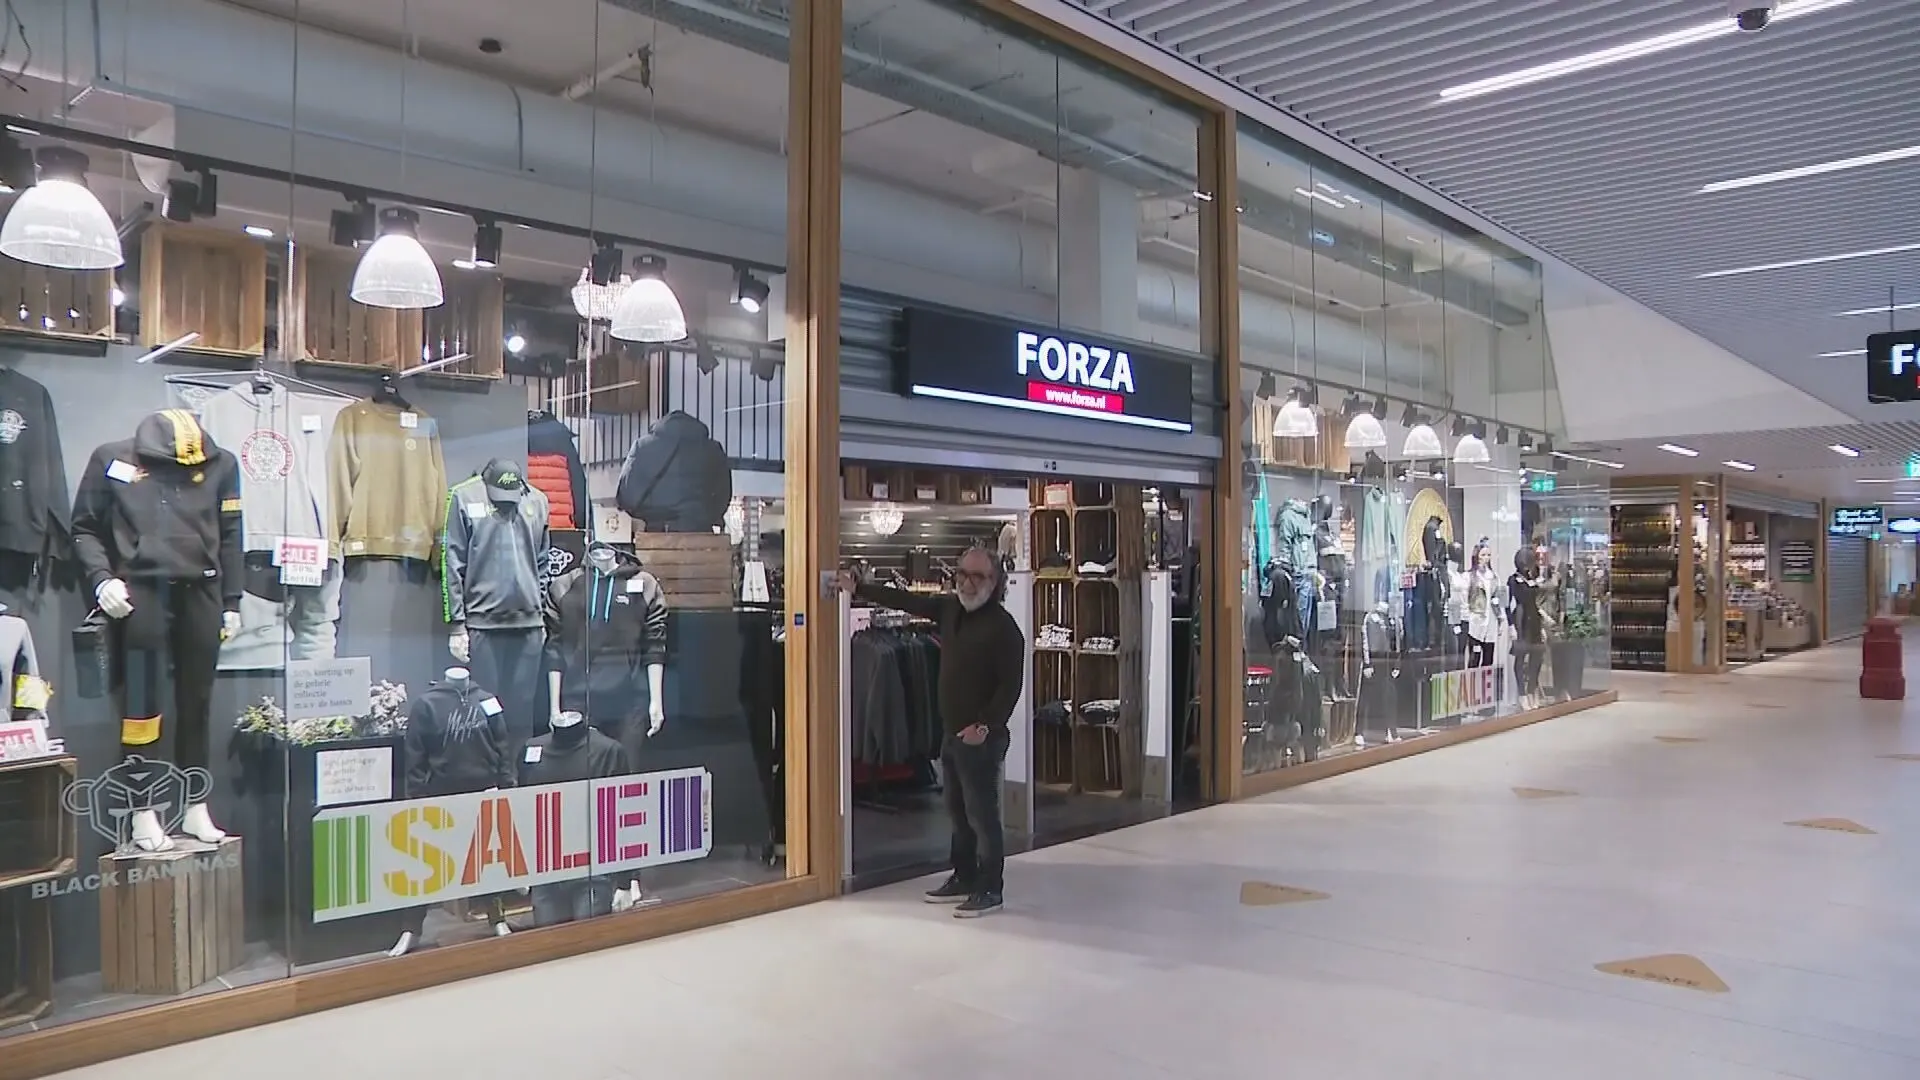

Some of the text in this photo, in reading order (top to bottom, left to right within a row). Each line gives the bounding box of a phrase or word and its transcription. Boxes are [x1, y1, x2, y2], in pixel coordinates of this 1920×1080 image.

[1018, 332, 1135, 393] FORZA
[1891, 344, 1920, 374] F
[1046, 390, 1105, 409] www.forza.nl
[281, 547, 317, 562] SALE
[1443, 669, 1493, 712] SALE
[383, 782, 649, 897] SALE
[31, 870, 119, 899] BLACK
